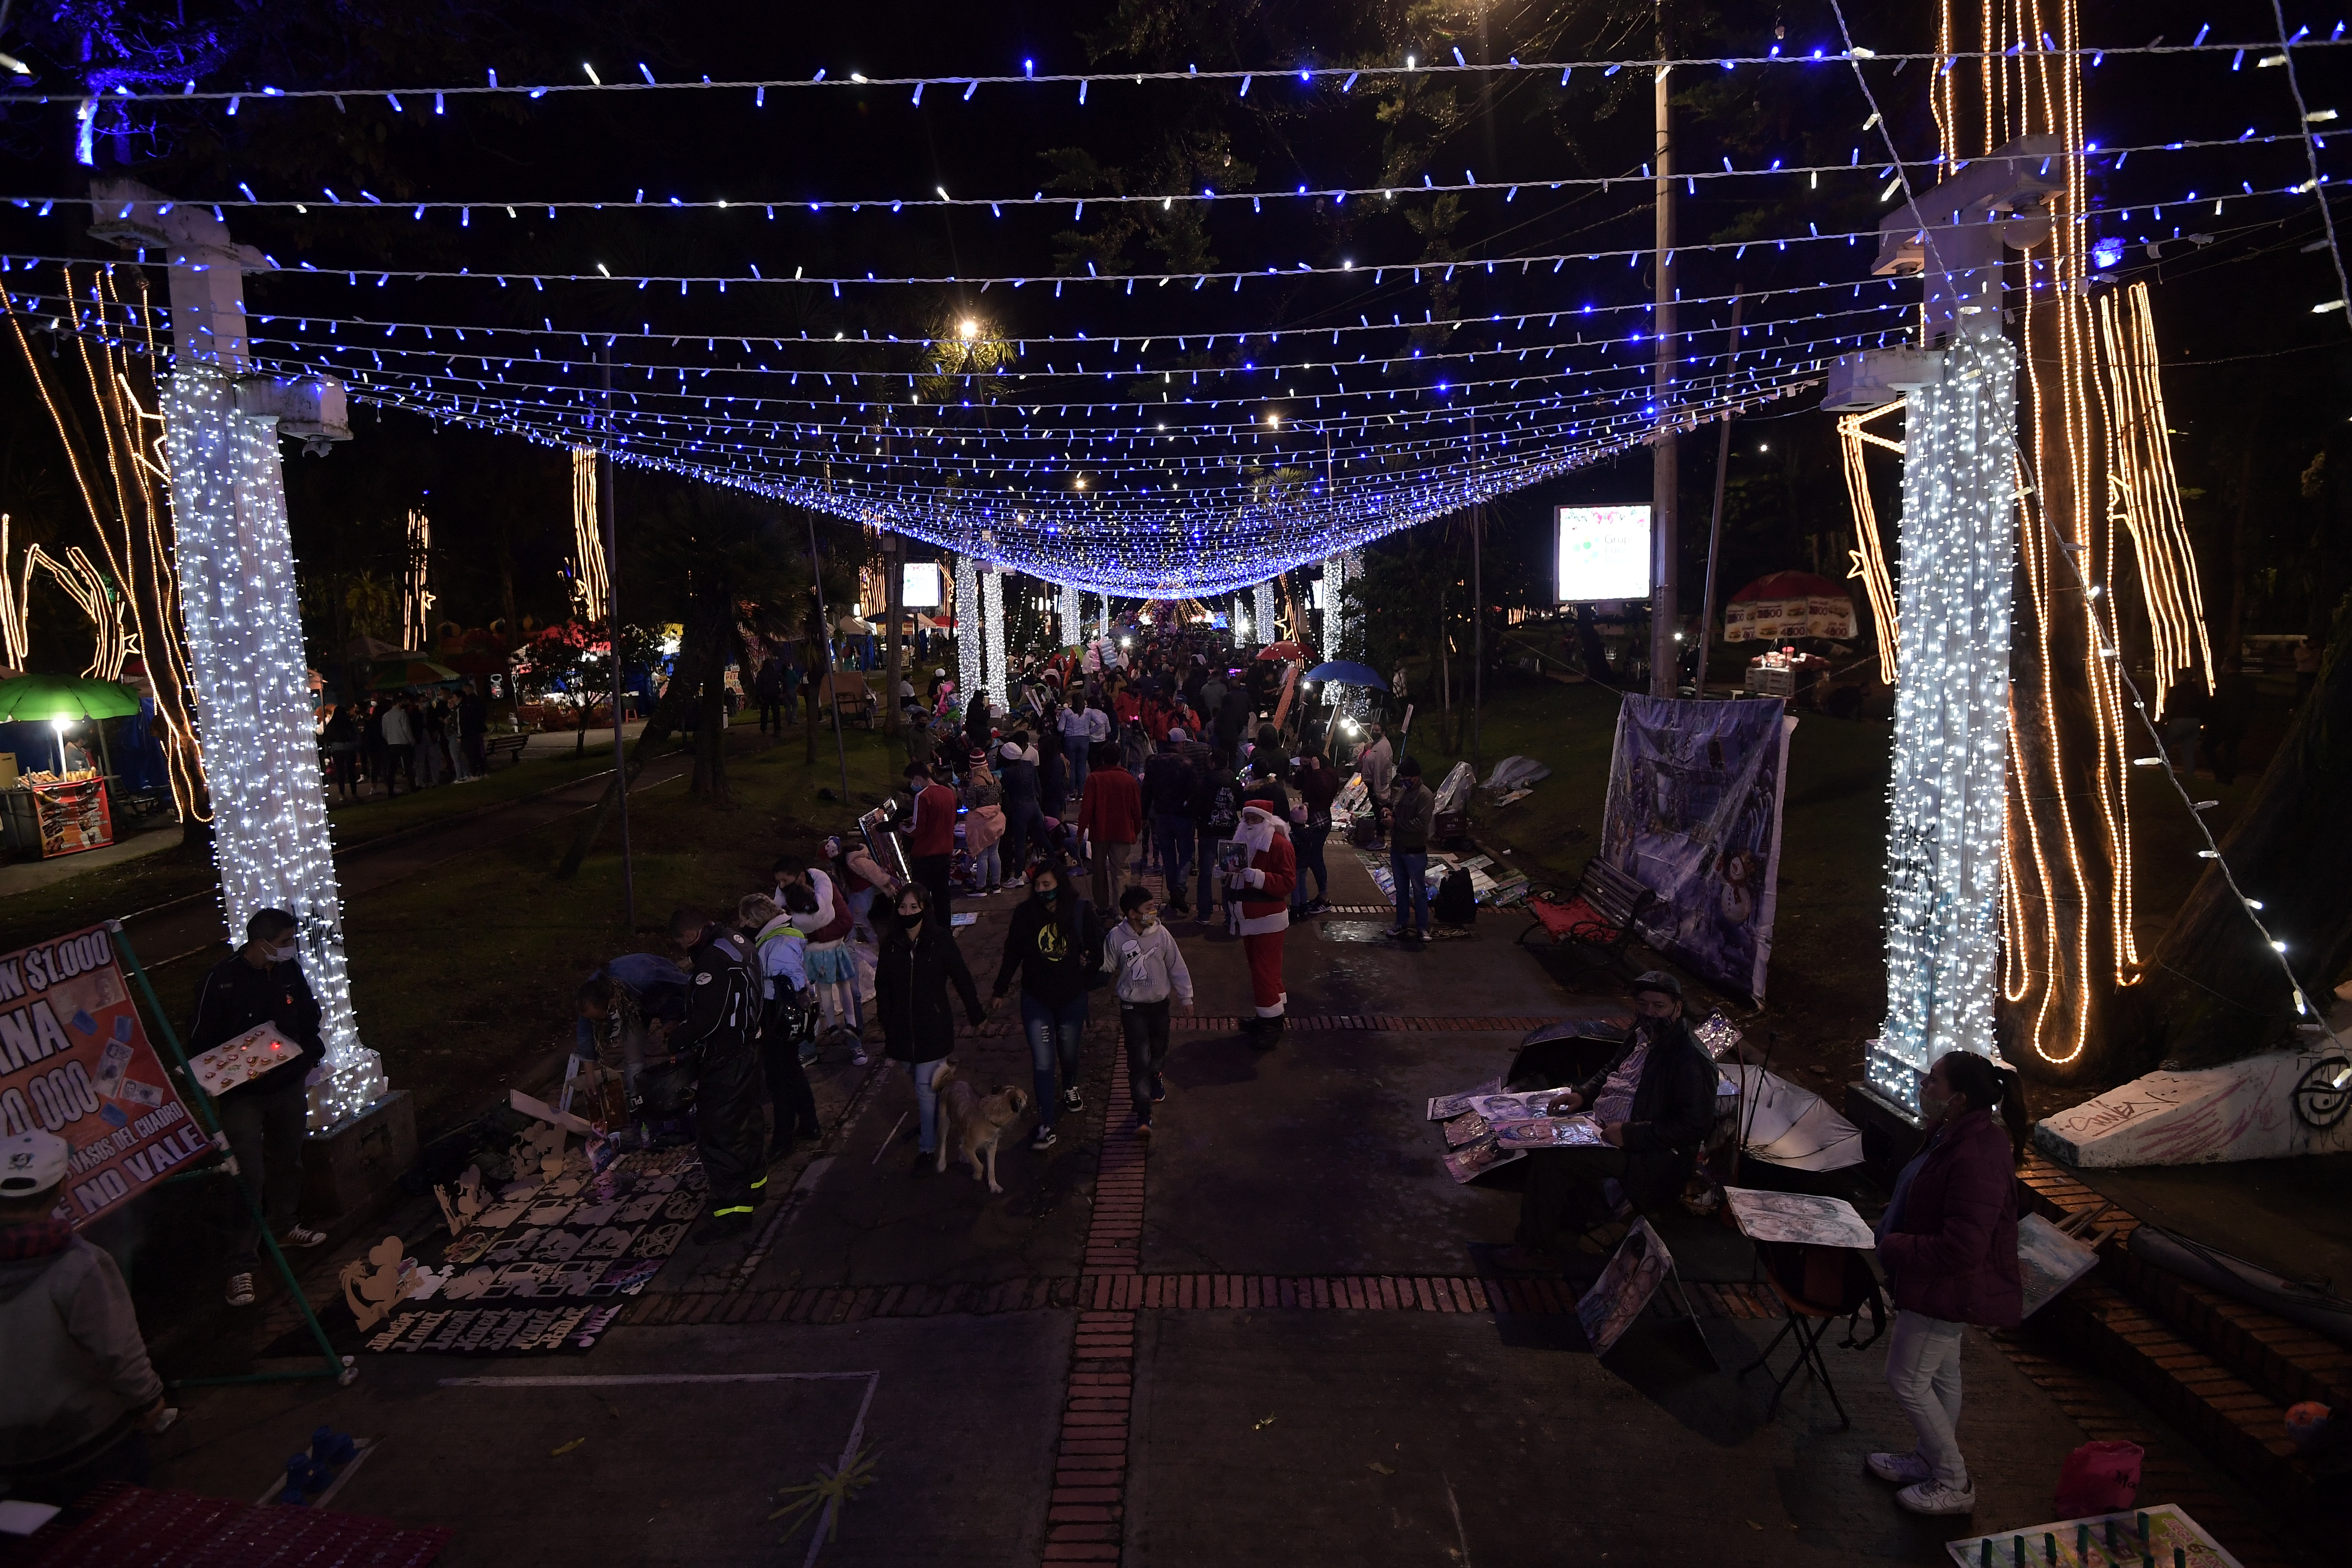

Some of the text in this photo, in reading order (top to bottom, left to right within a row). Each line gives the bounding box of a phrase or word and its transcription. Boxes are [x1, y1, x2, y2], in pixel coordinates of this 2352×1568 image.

[1605, 534, 1632, 545] Grup
[24, 929, 112, 992] $1.000
[69, 1100, 185, 1175] VASOS DEL CUADRO
[72, 1168, 128, 1215] NO
[122, 1123, 209, 1182] VALE
